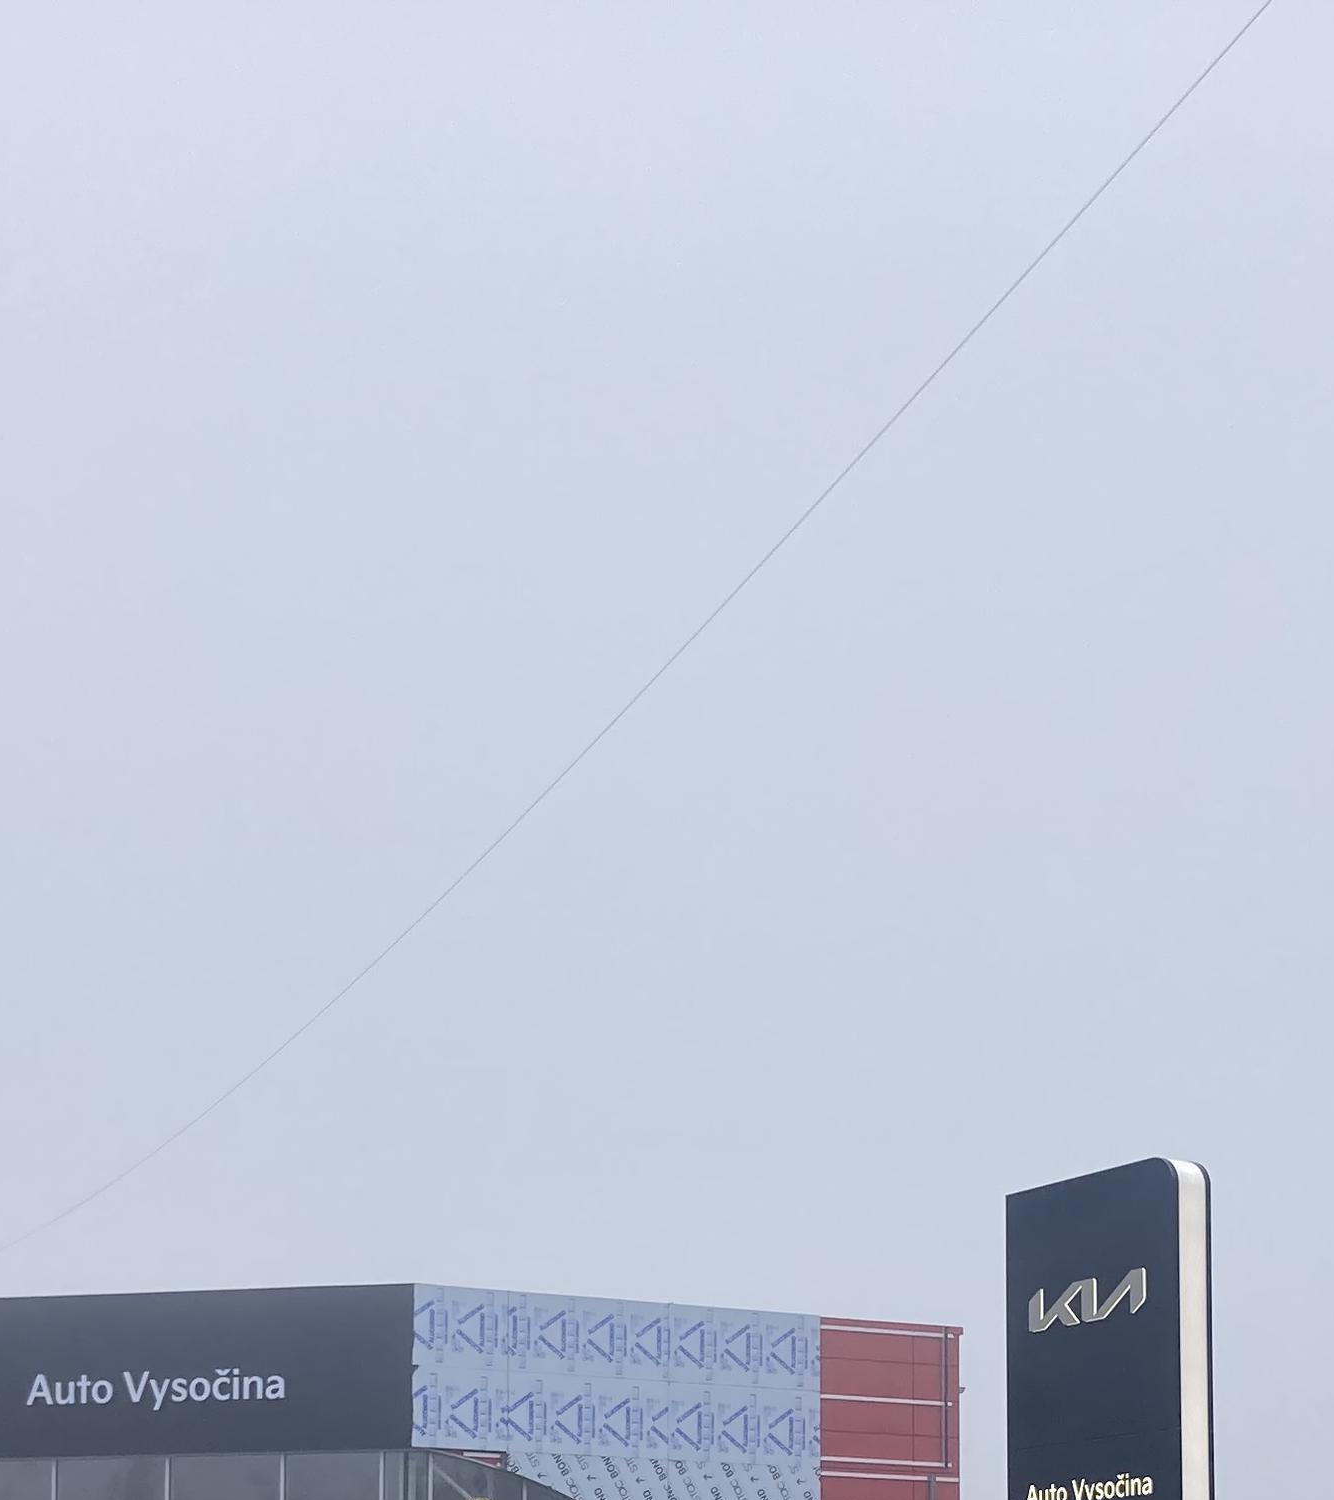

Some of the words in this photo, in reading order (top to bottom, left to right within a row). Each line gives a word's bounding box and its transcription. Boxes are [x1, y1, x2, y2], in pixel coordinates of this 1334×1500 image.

[1028, 1267, 1147, 1333] KIA
[26, 1373, 113, 1406] Auto
[123, 1368, 286, 1411] Vysočina
